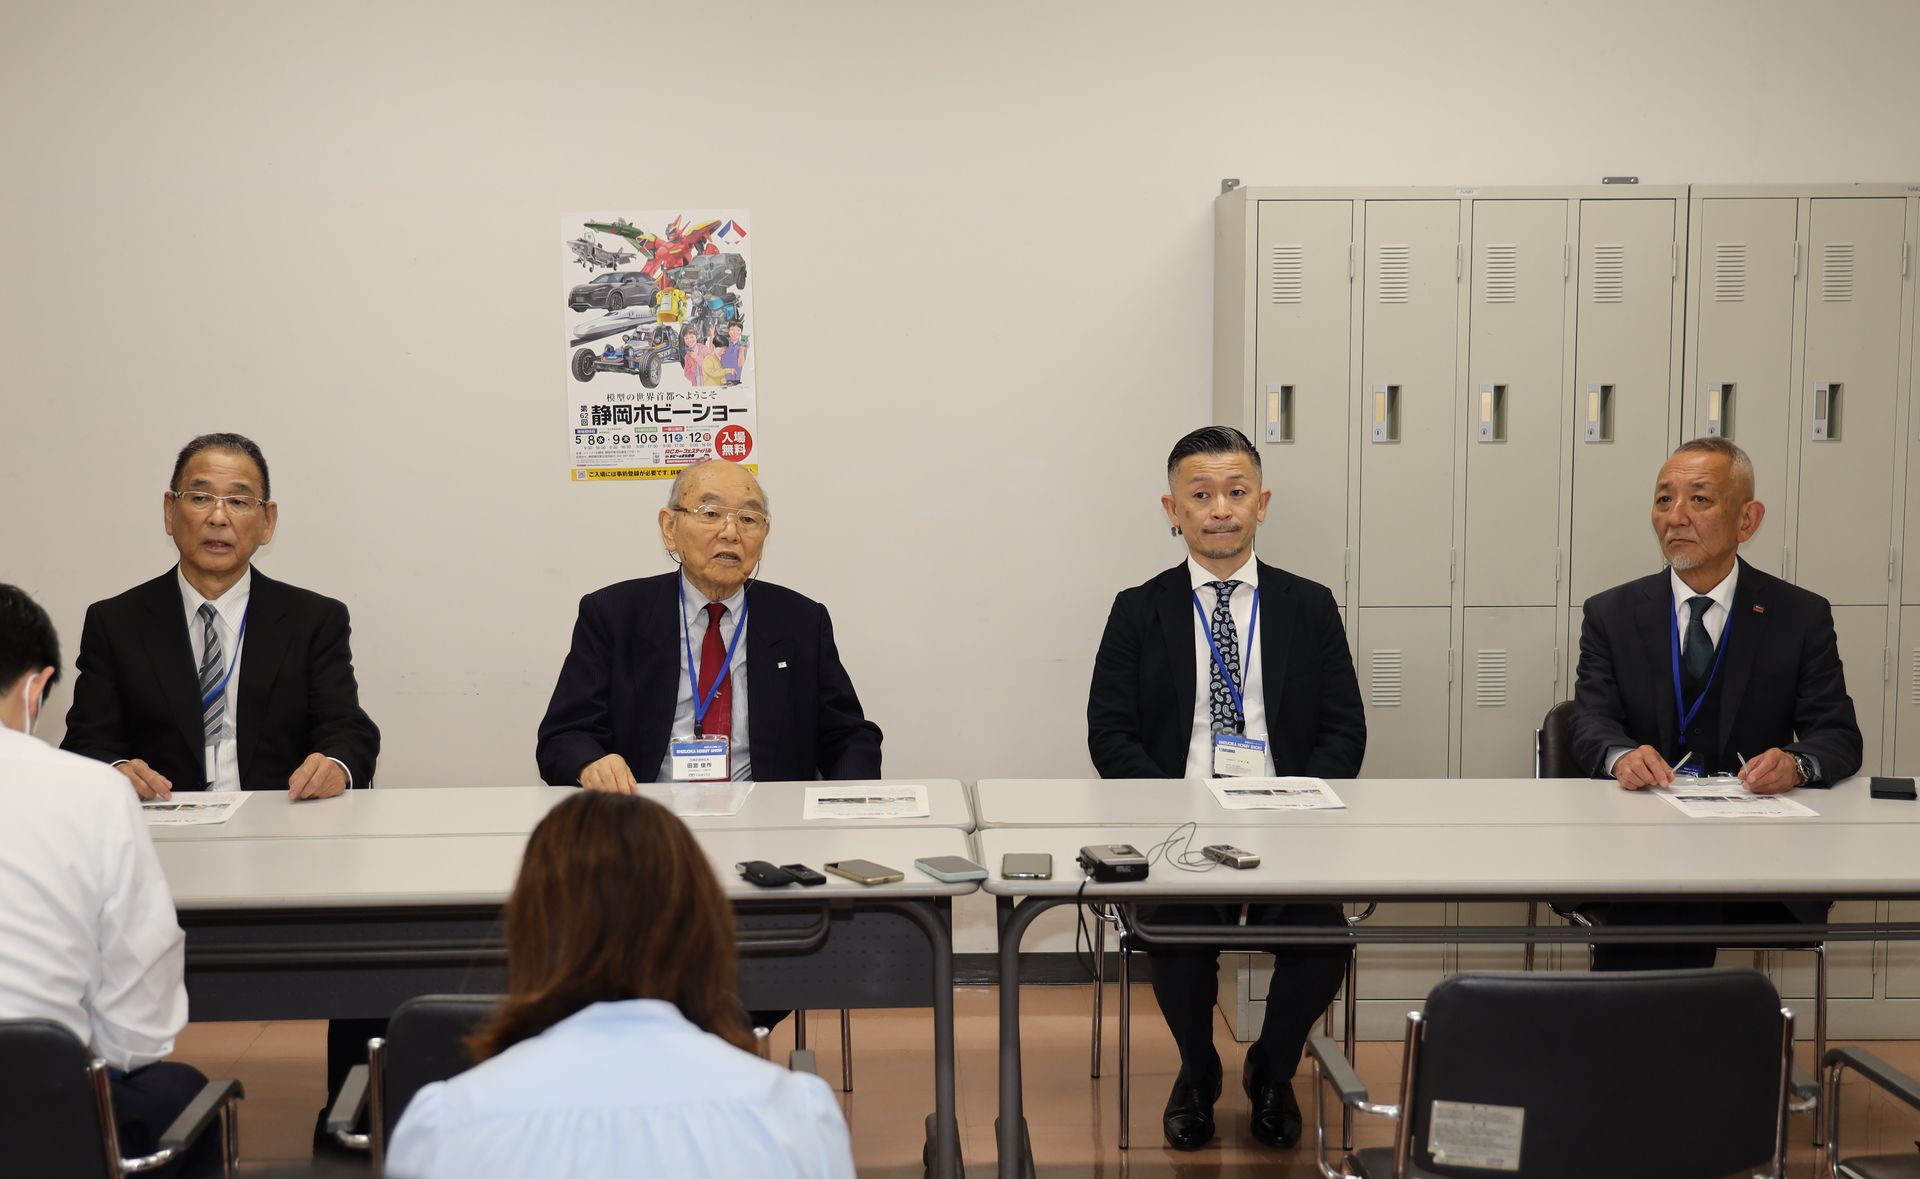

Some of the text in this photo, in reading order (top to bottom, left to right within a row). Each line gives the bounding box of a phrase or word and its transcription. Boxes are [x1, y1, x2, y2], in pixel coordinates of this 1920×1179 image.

[607, 391, 717, 402] 模型の世界首都へようこそ
[580, 405, 589, 426] 第62回
[591, 403, 748, 426] 静岡ホビーショー
[722, 431, 746, 443] 入場
[722, 444, 746, 456] 無料
